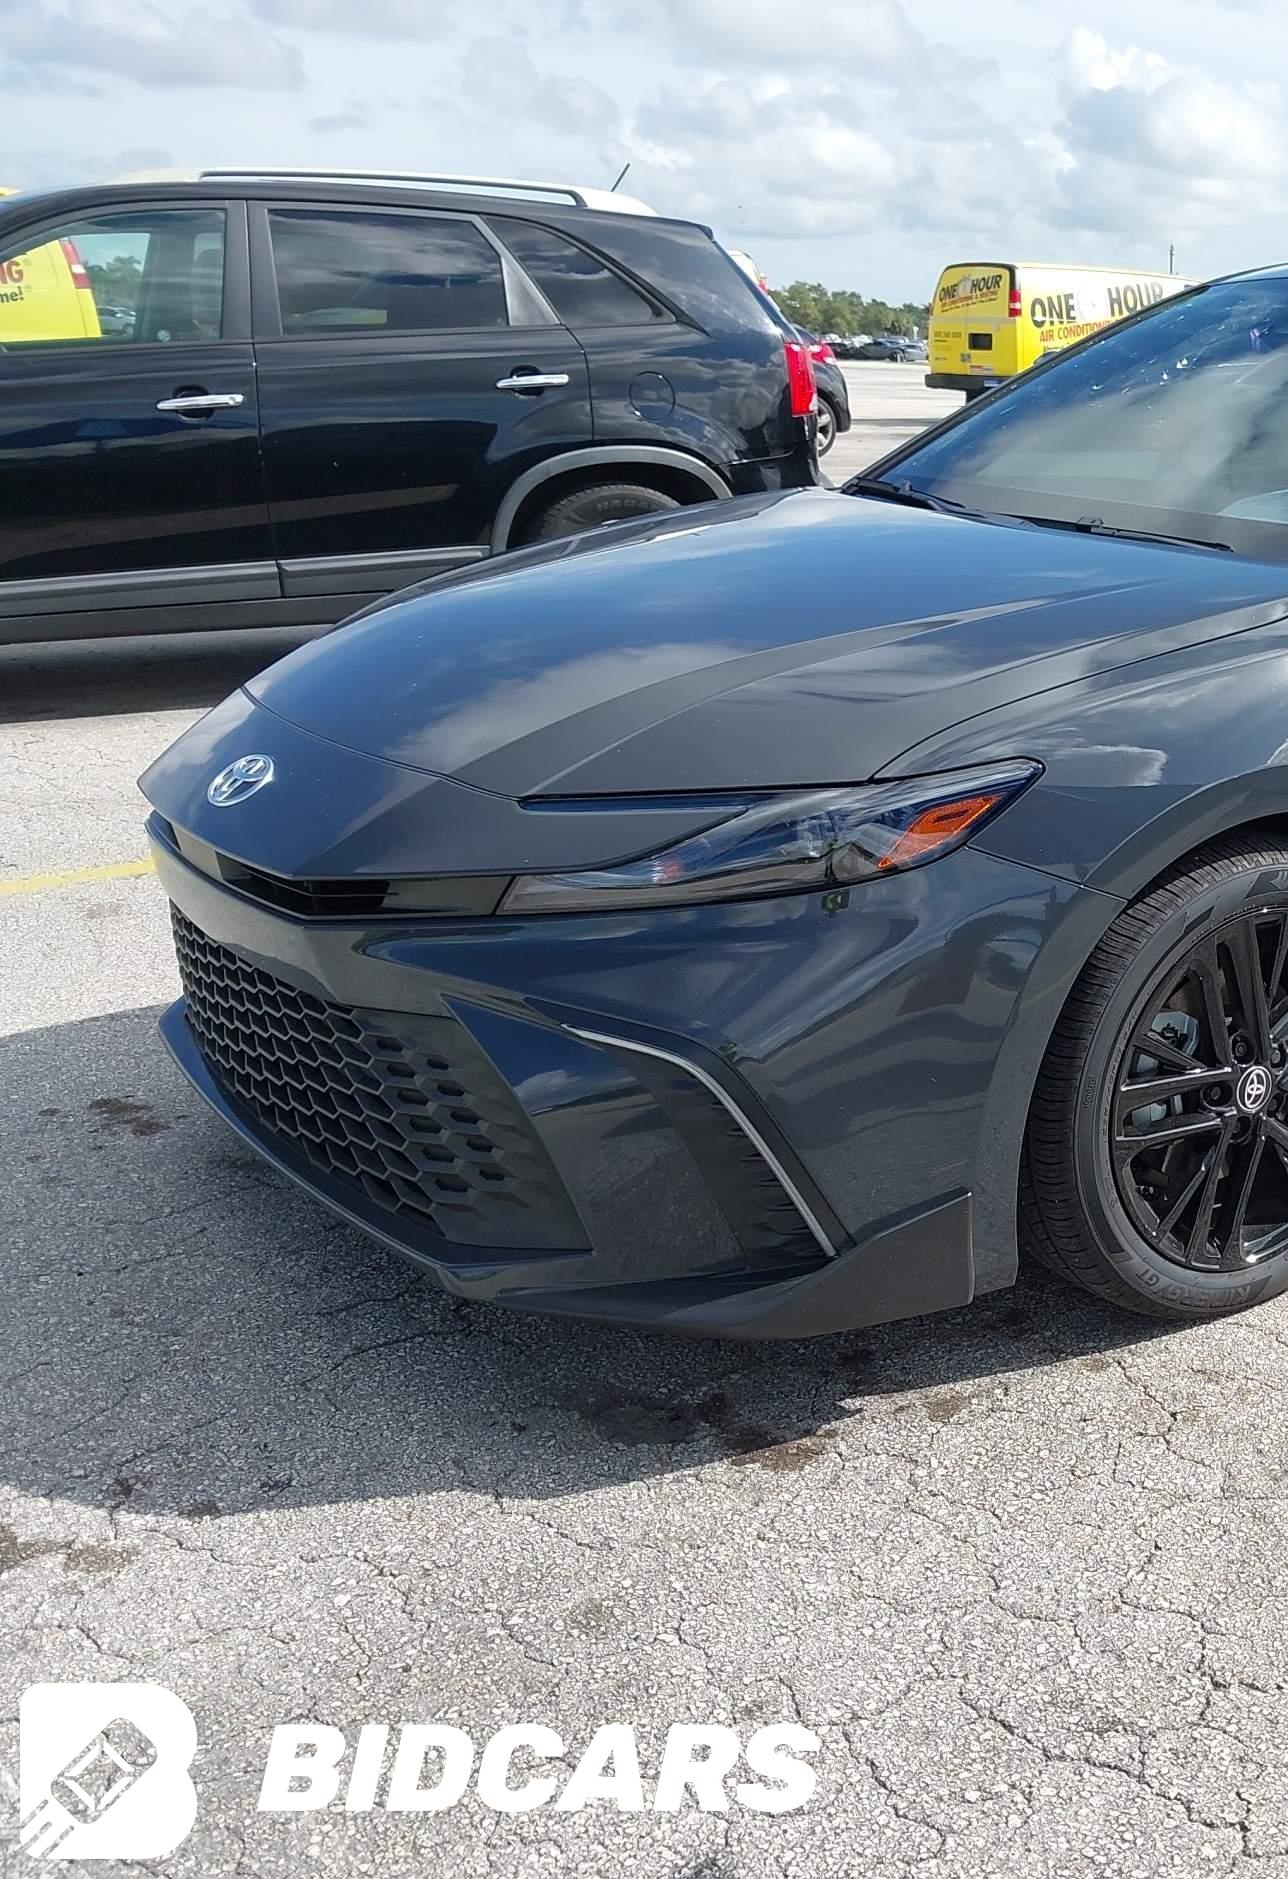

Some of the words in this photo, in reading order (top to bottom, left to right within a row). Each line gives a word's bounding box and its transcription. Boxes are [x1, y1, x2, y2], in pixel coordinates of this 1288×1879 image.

[939, 283, 958, 303] ONE
[970, 274, 1003, 293] HOUR
[1030, 293, 1076, 329] ONE
[1106, 281, 1164, 317] HOUR
[1040, 329, 1055, 342] AIR
